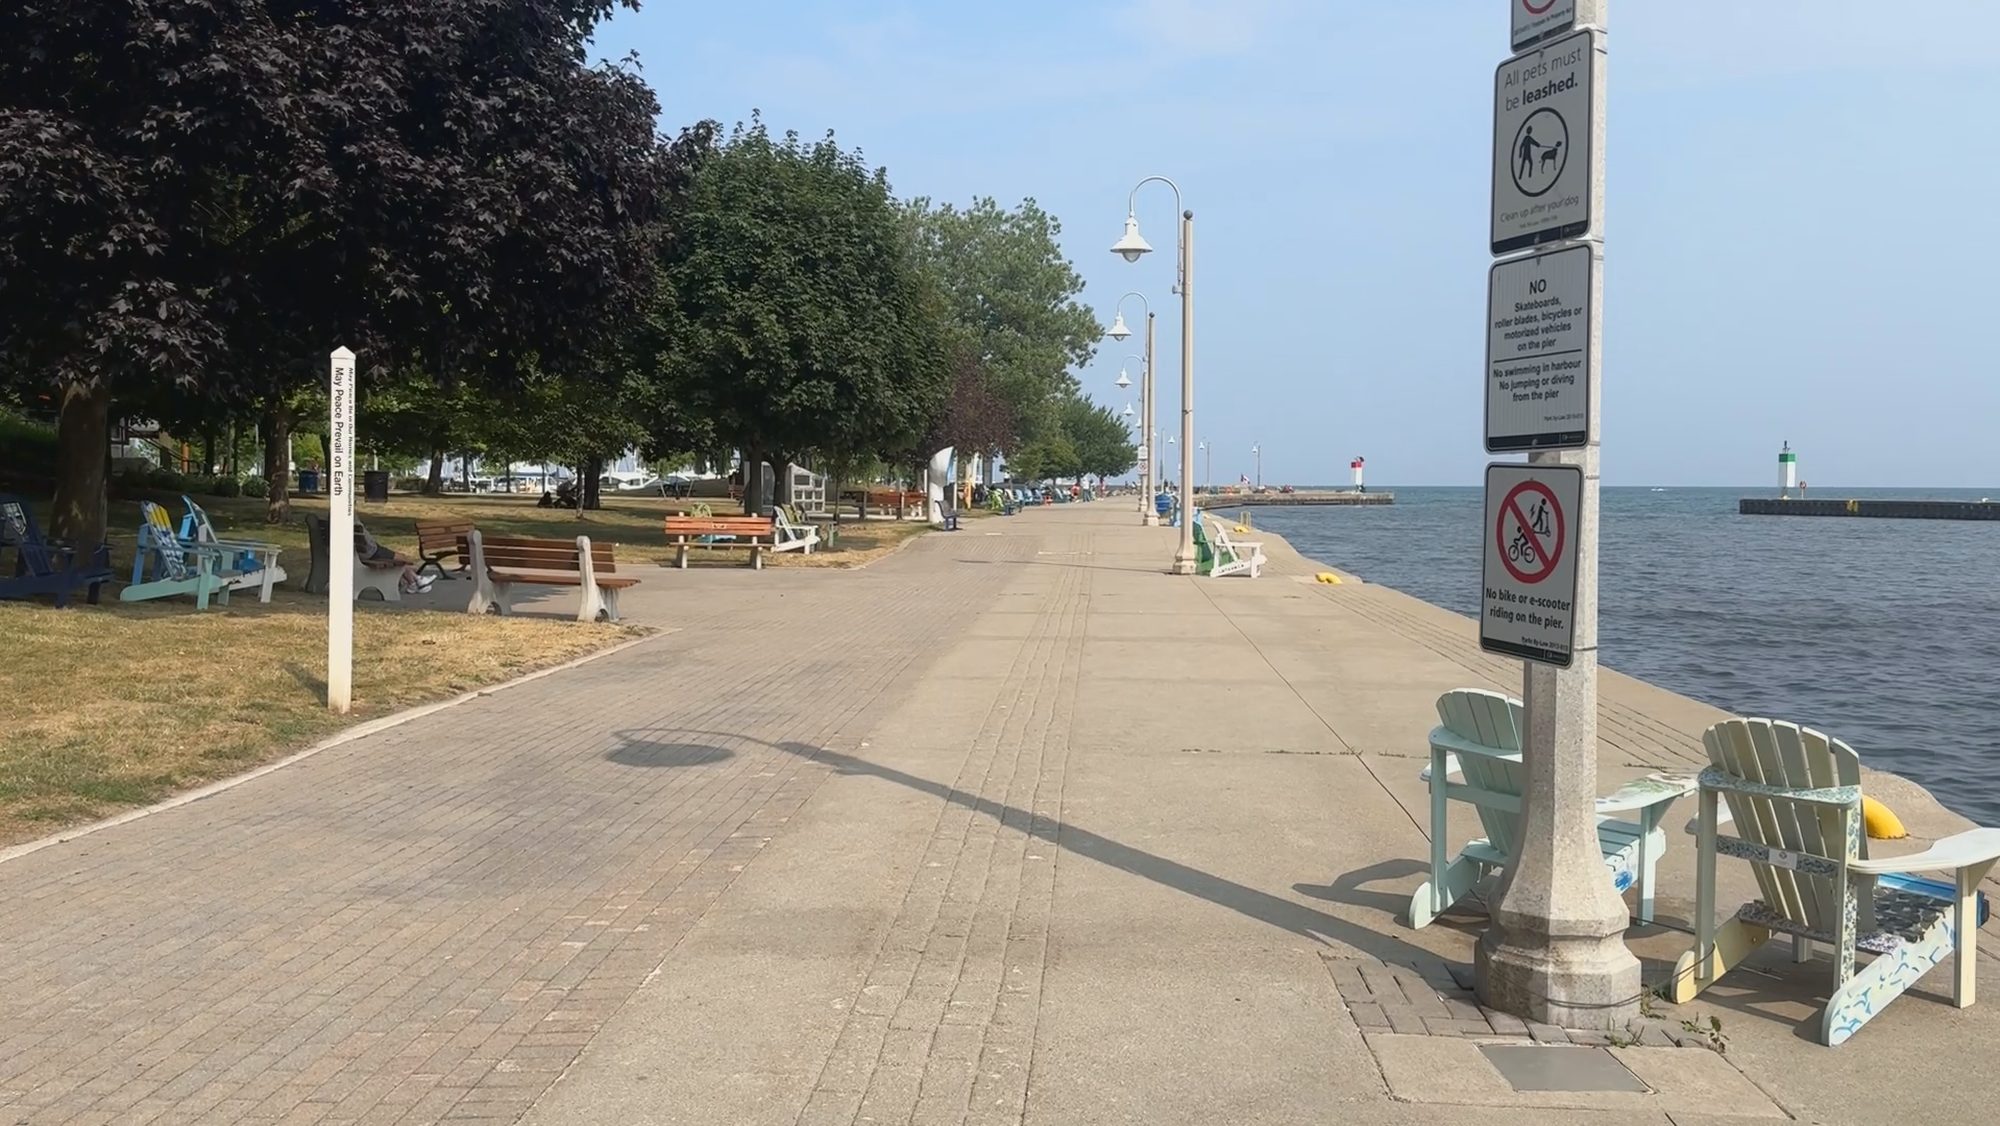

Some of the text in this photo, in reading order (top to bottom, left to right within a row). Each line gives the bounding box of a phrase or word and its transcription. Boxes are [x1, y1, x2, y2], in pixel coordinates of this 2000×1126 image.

[1504, 48, 1581, 89] All pets must
[1505, 72, 1578, 111] be leashed.
[1500, 211, 1519, 222] Clean
[1520, 209, 1529, 218] up
[1530, 204, 1545, 215] after
[1547, 198, 1564, 213] your
[1564, 195, 1579, 207] dog
[1529, 279, 1547, 295] NO
[1514, 296, 1562, 312] Skateboards,
[1495, 307, 1582, 328] roller blades, bicycles or
[1504, 322, 1572, 339] motorized vehicles
[1517, 337, 1557, 351] on the pier
[1493, 360, 1581, 378] No swimming in harbour
[1499, 374, 1575, 392] No jumping or diving
[1513, 389, 1559, 402] from the pier
[333, 367, 345, 496] May Peace Prevail on Earth
[1486, 587, 1571, 611] No bike or e-scooter
[1490, 606, 1564, 630] riding on the pier.
